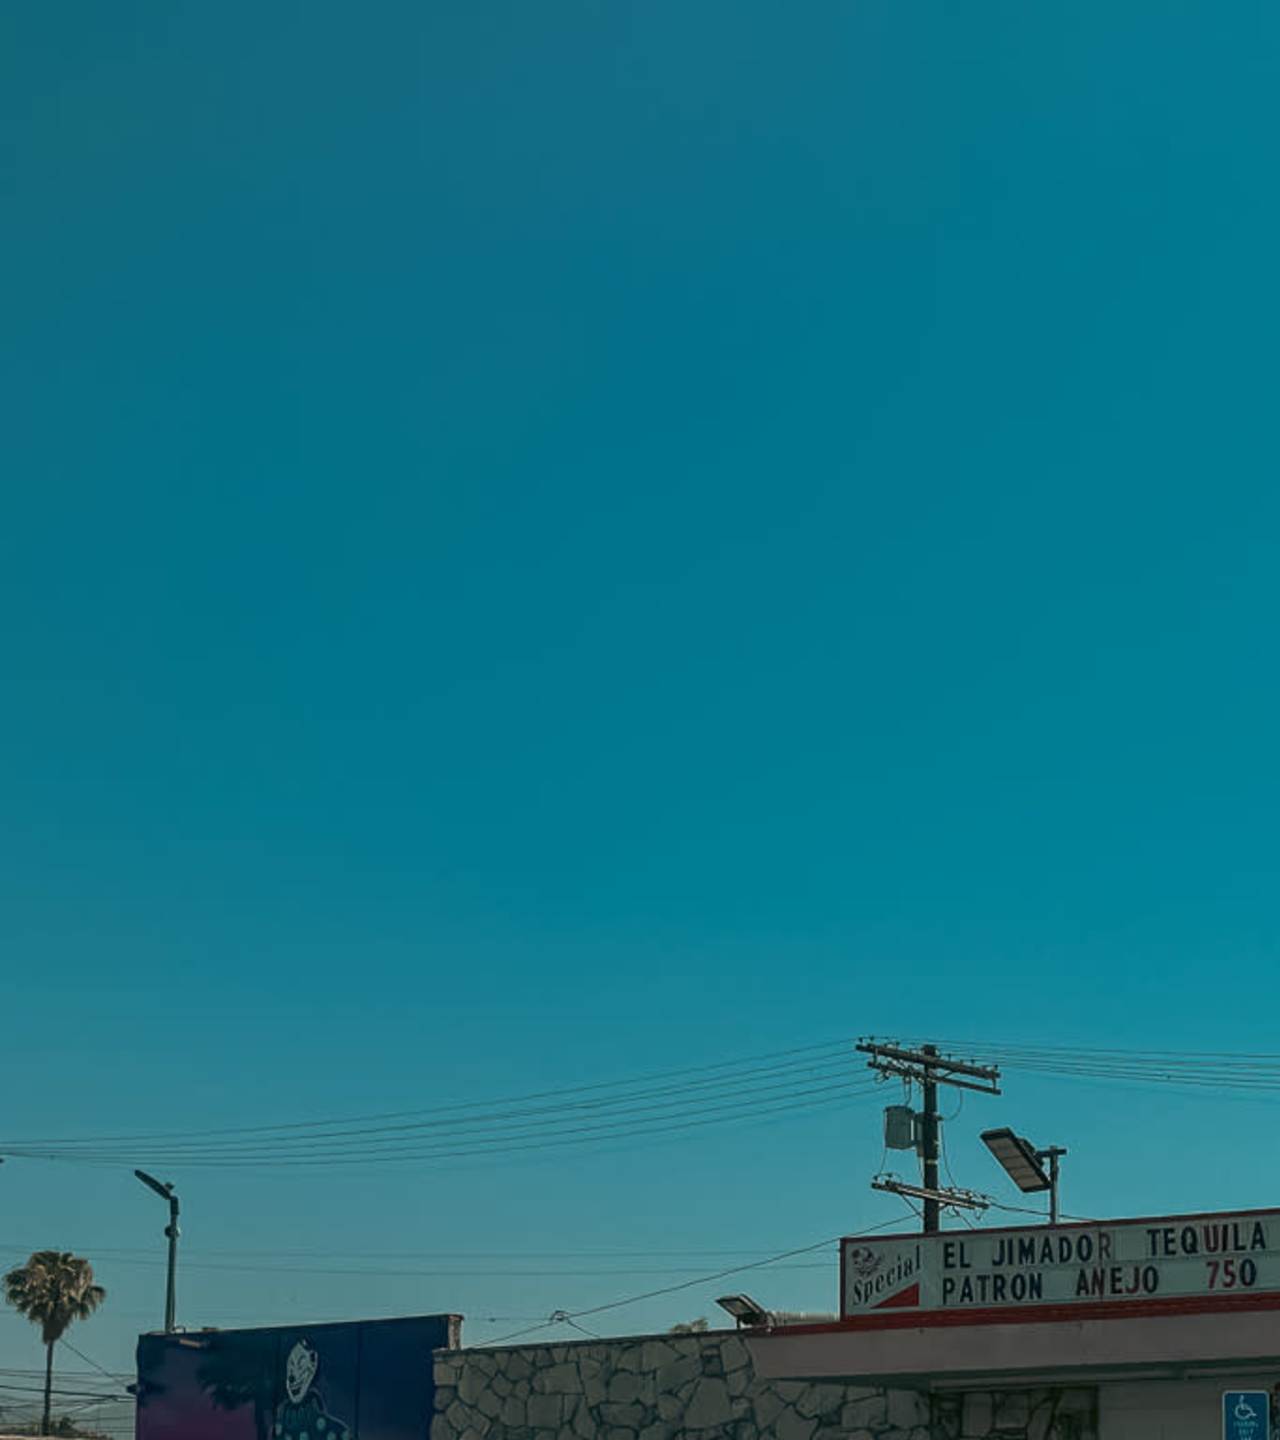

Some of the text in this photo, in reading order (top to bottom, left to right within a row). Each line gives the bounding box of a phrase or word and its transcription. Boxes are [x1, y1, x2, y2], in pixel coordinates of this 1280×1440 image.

[943, 1241, 971, 1269] EL
[992, 1232, 1112, 1266] JIMADOR
[1147, 1221, 1266, 1257] TEQUILA
[852, 1244, 921, 1306] Special
[943, 1272, 1043, 1305] PATRON
[1076, 1265, 1159, 1297] ANEJO
[1206, 1259, 1257, 1289] 750
